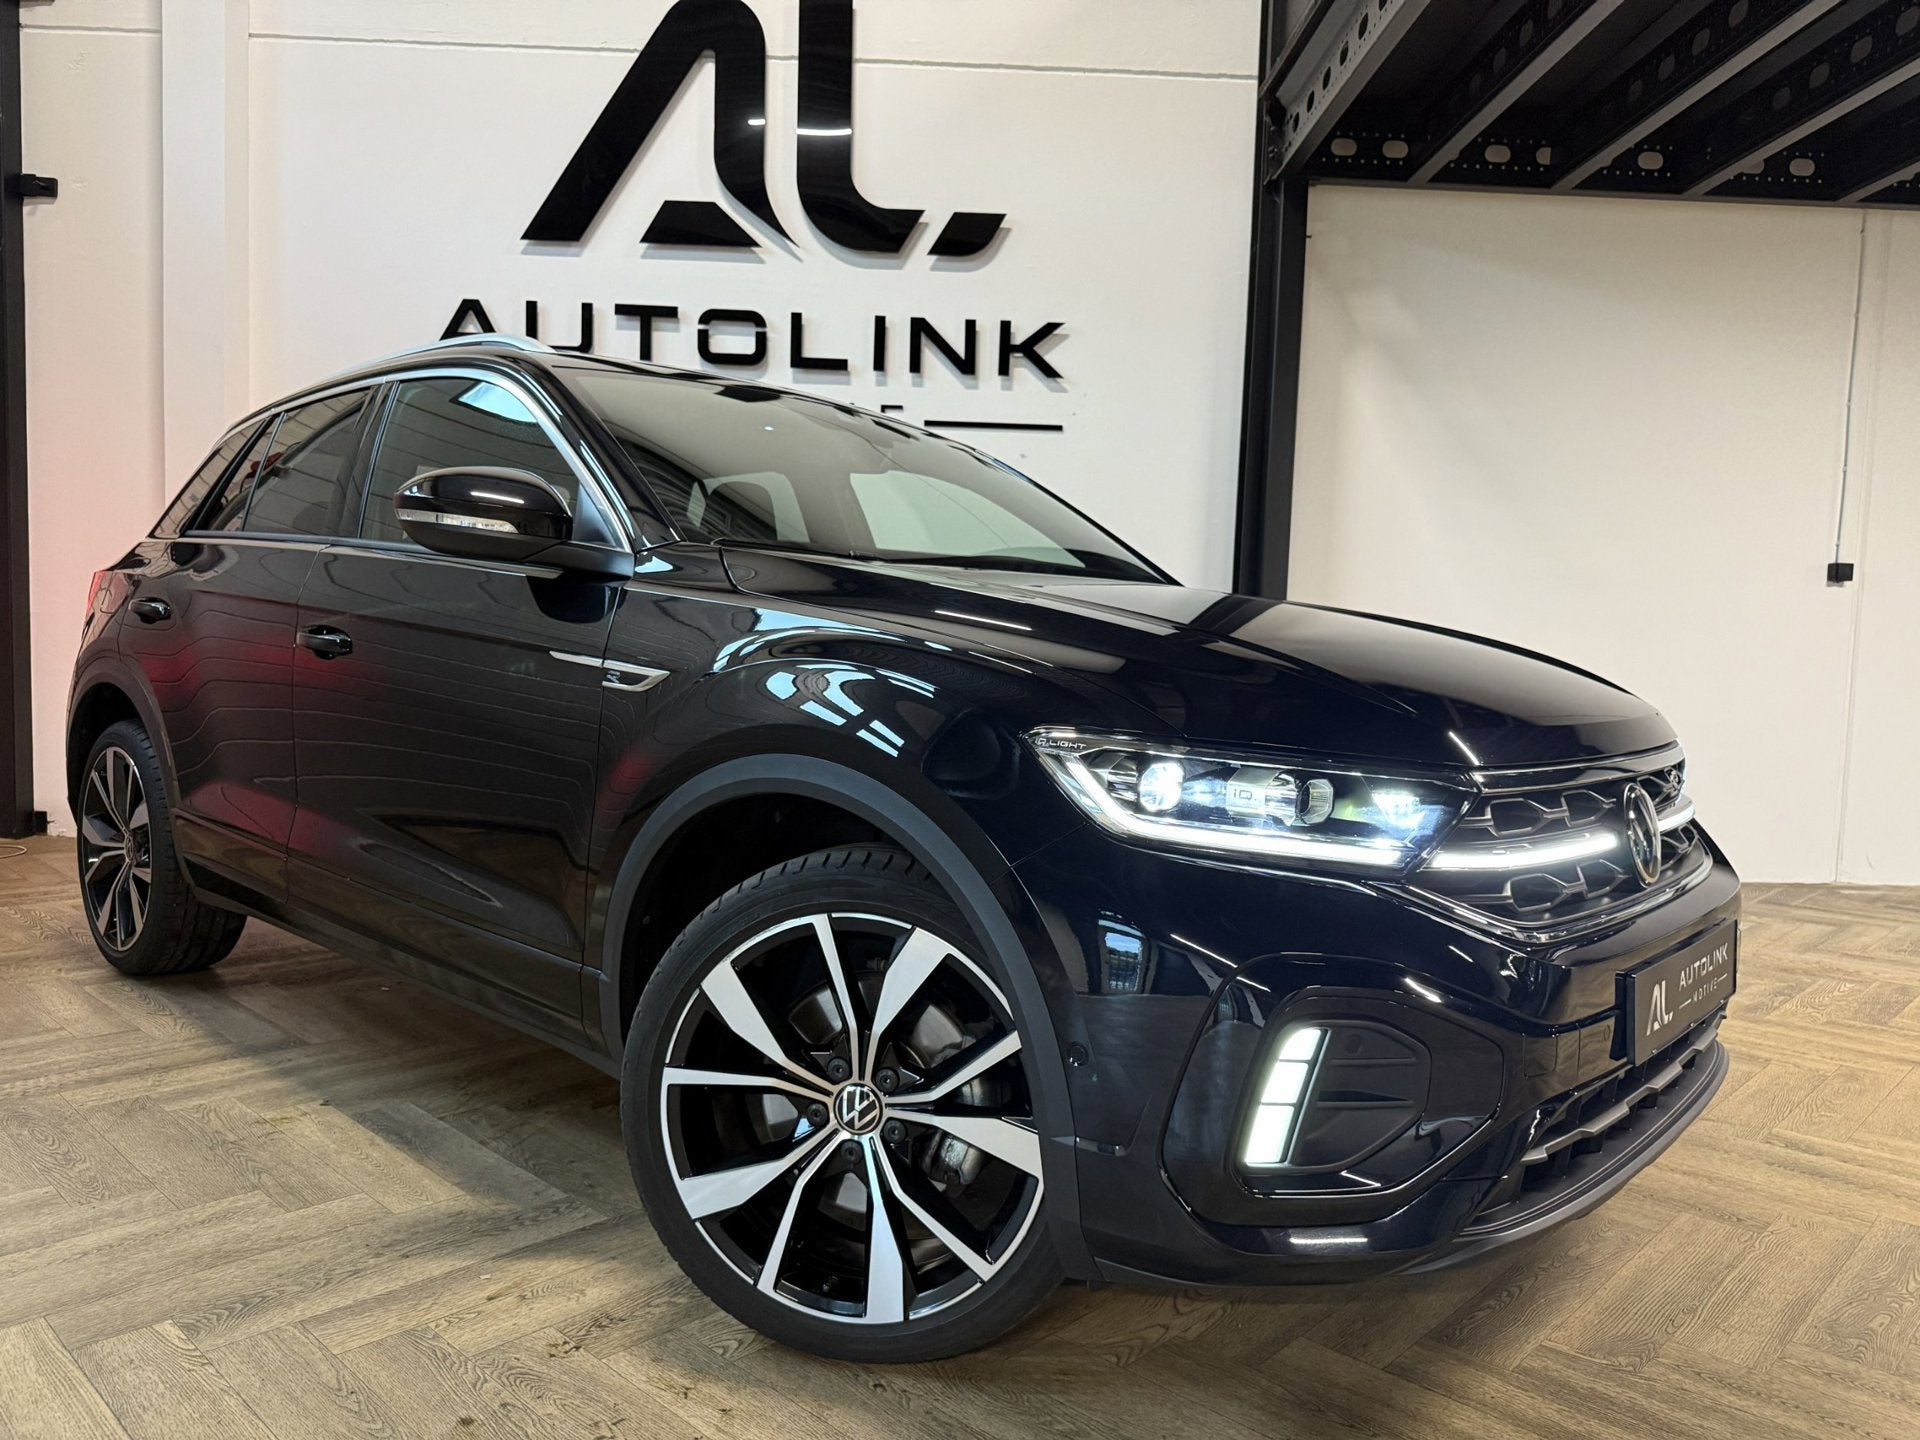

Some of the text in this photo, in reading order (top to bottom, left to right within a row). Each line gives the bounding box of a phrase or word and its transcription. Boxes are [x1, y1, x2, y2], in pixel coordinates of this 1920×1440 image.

[438, 298, 1066, 380] AUTOLINK
[1678, 942, 1728, 992] AUTOLINK
[1692, 977, 1718, 1003] MOTIVE
